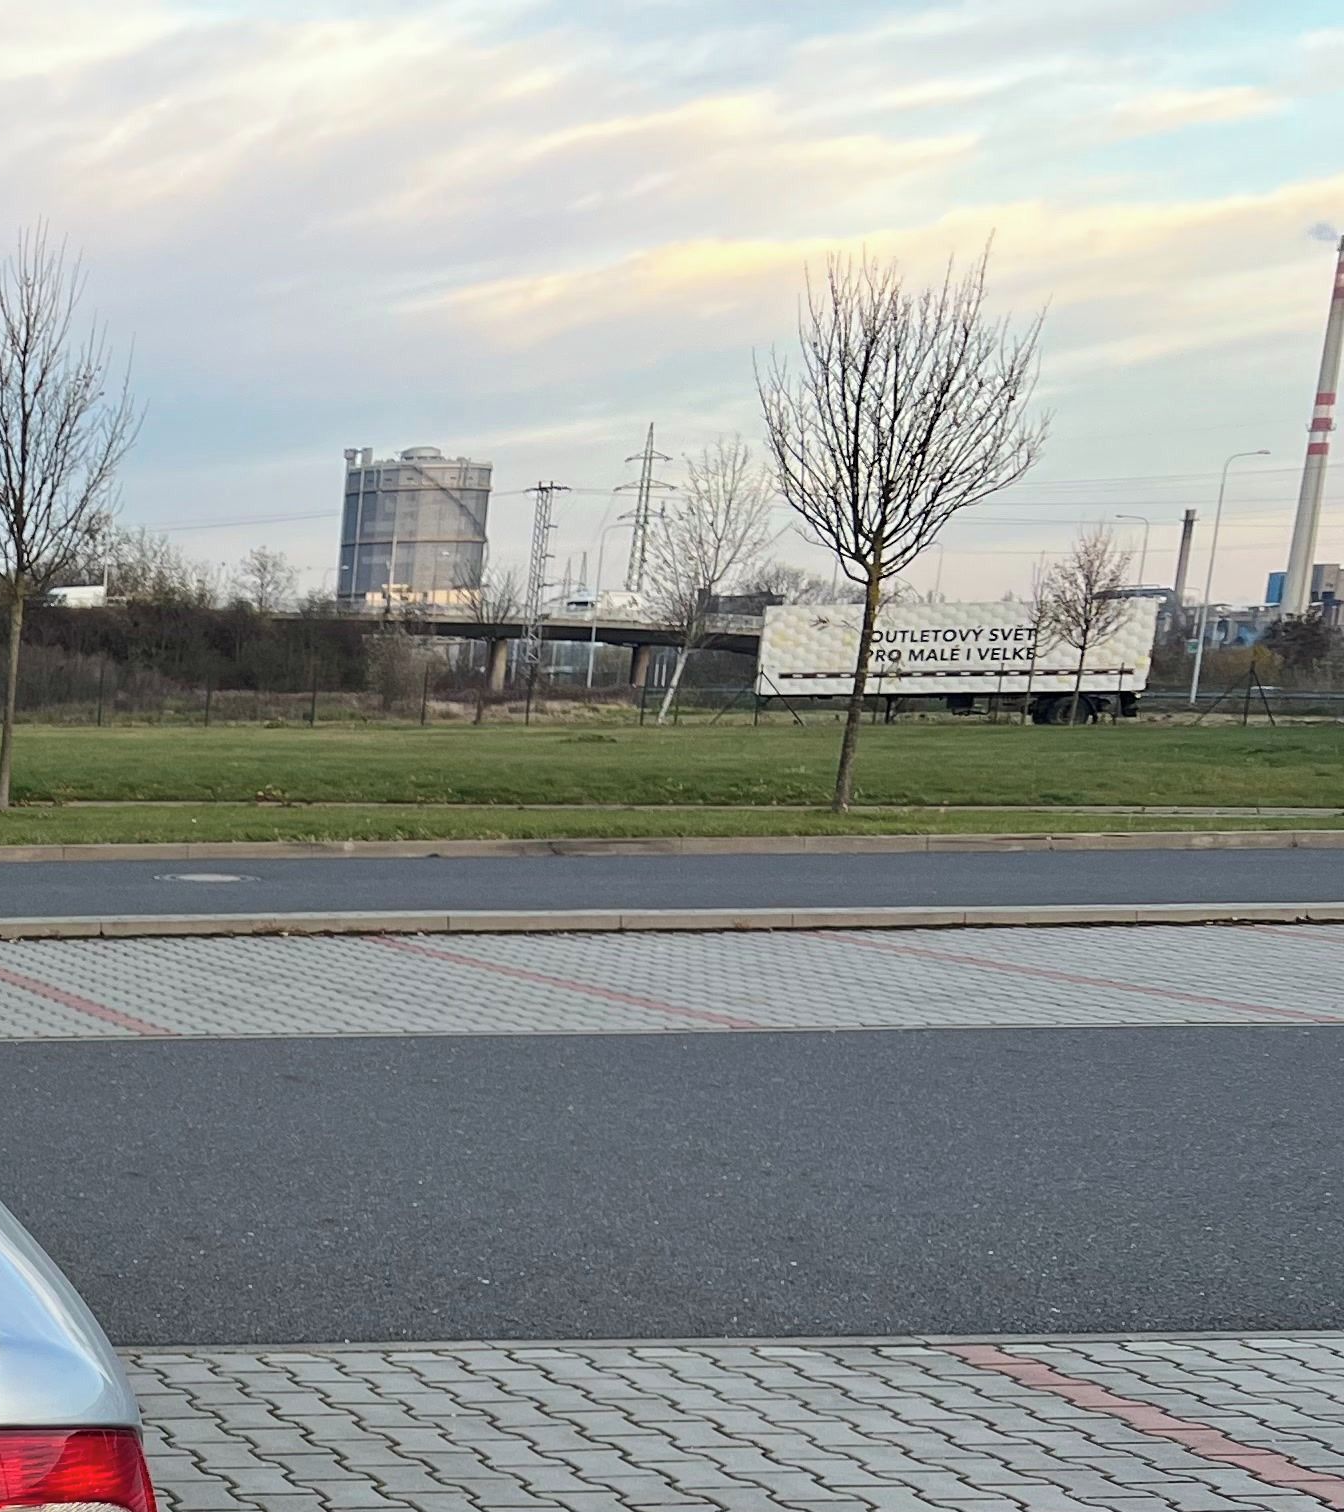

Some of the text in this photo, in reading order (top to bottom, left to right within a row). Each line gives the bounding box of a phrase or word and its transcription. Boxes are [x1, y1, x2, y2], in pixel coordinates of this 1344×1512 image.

[870, 624, 1037, 643] OUTLETOVÝ SVĚT
[908, 645, 960, 662] MALÉ
[965, 648, 971, 661] I
